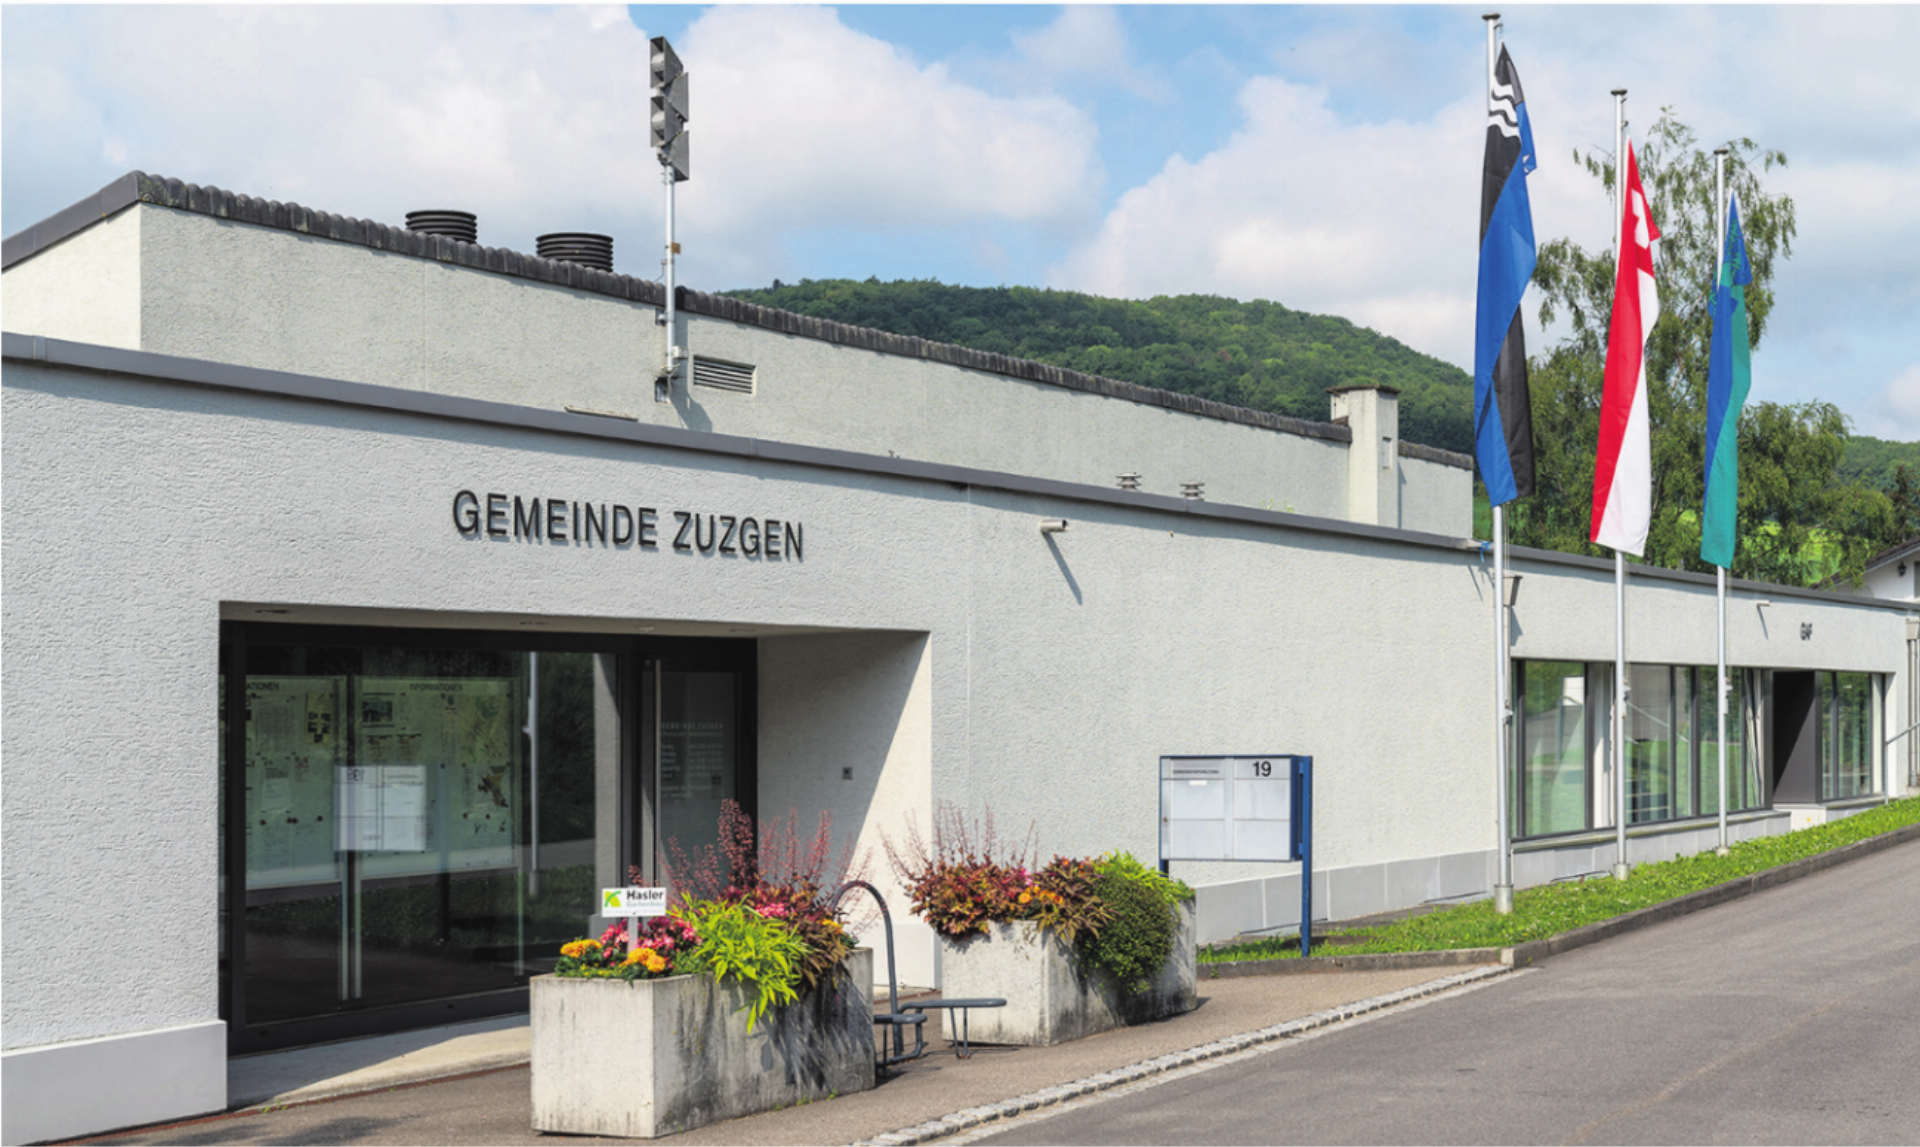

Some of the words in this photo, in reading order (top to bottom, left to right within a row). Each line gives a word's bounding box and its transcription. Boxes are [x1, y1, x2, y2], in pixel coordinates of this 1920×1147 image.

[452, 490, 657, 547] GEMEINDE
[672, 511, 803, 560] ZUZGEN
[1253, 761, 1272, 777] 19
[626, 889, 664, 900] Hasler
